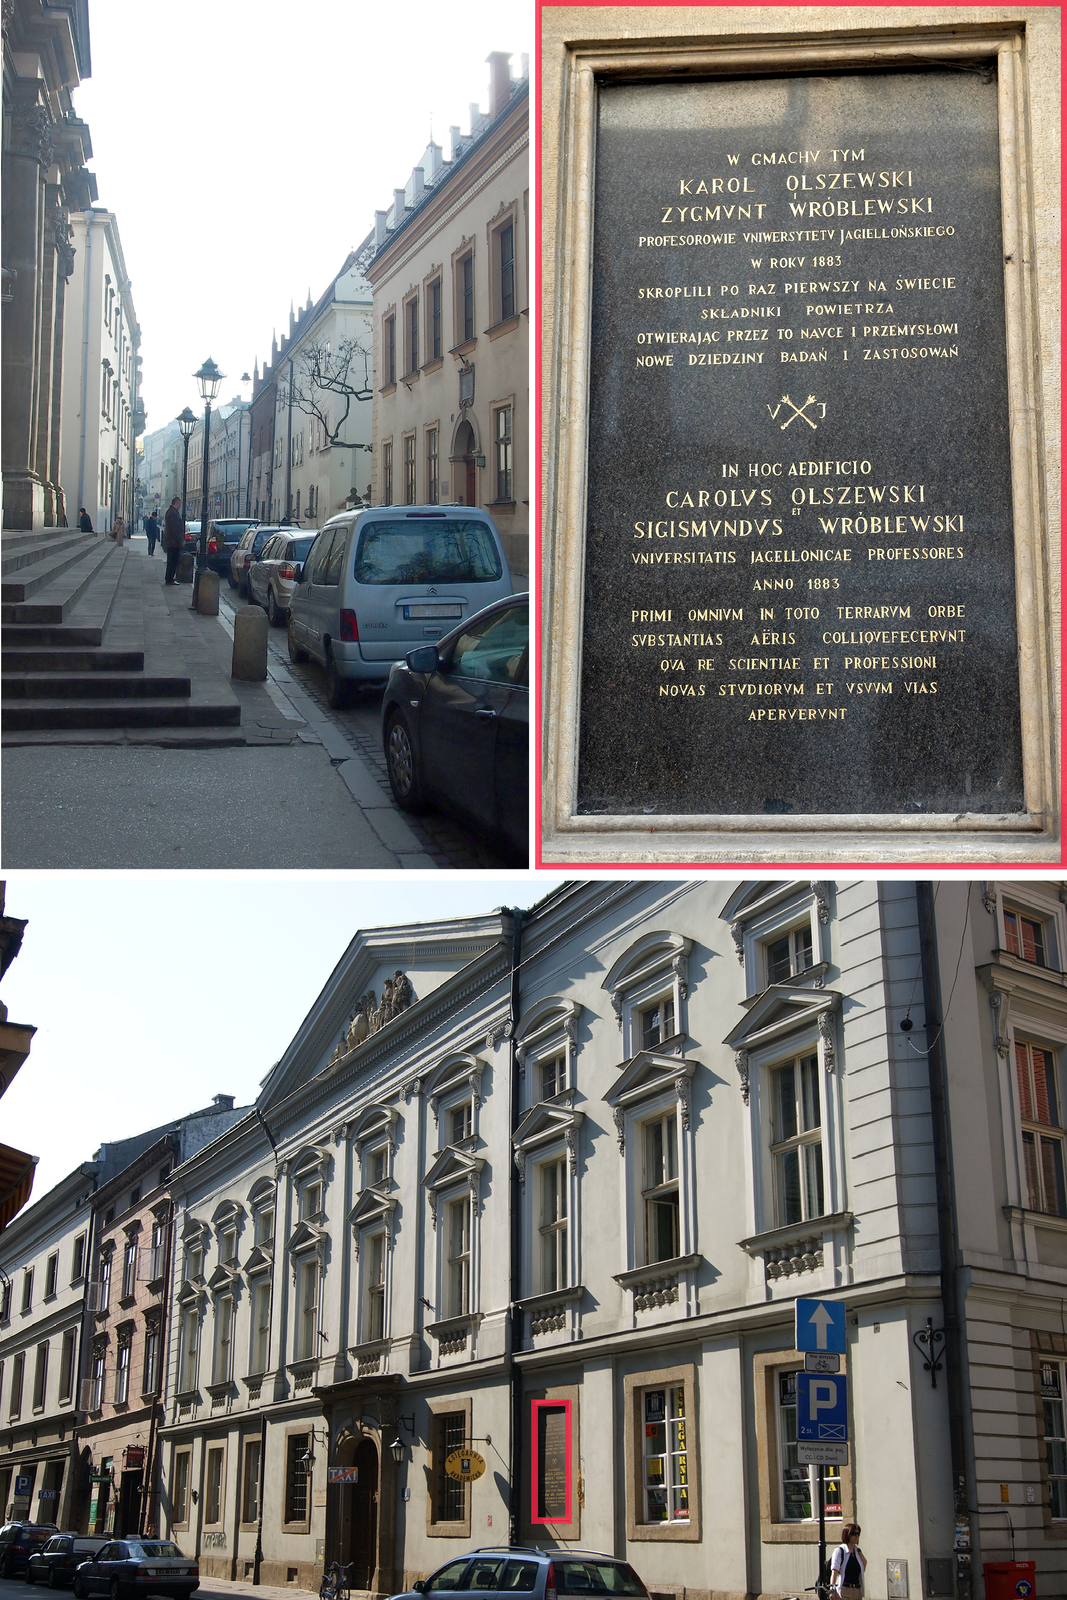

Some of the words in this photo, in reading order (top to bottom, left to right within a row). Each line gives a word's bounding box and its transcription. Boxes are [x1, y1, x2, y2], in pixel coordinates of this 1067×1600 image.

[727, 154, 741, 166] W
[752, 151, 821, 166] GMACHV
[831, 149, 865, 162] TYM
[680, 178, 756, 195] KAROL
[787, 171, 913, 191] OLSZEWSKI
[662, 204, 767, 223] ZYGMVNT
[790, 197, 933, 218] WRÓBLEWSKI
[639, 233, 736, 248] PROFESOROWIE
[743, 230, 836, 244] VNIWERSYTETV
[840, 226, 955, 246] JAGIELLOŃSKIEGO
[751, 259, 763, 269] W
[771, 257, 806, 269] ROKV
[813, 256, 842, 268] 1883
[638, 286, 712, 299] SKROPLILI
[721, 286, 739, 296] PO
[749, 284, 776, 295] RAZ
[785, 281, 860, 294] PIERWSZY
[869, 281, 887, 292] NA
[896, 275, 956, 291] ŚWIECIE
[701, 307, 781, 320] SKŁADNIKI
[807, 304, 894, 316] POWIETRZA
[638, 331, 720, 346] OTWIERAJĄC
[728, 330, 769, 342] PRZEZ
[777, 329, 793, 340] TO
[801, 327, 844, 339] NAVCE
[852, 327, 856, 338] I
[864, 324, 958, 337] PRZEMYSŁOWI
[637, 355, 674, 367] NOWE
[689, 353, 765, 366] DZIEDZINY
[781, 347, 828, 363] BADAŃ
[844, 351, 848, 361] I
[864, 344, 959, 360] ZASTOSOWAŃ
[722, 464, 739, 478] IN
[749, 463, 783, 477] HOC
[788, 461, 872, 476] AEDIFICIO
[666, 490, 772, 509] CAROLVS
[792, 485, 925, 505] OLSZEWSKI
[635, 519, 783, 539] SIGISMVNDVS
[818, 512, 964, 535] WRÓBLEWSKI
[632, 552, 736, 564] VNIVERSITATIS
[751, 549, 852, 565] JAGELLONICAE
[868, 547, 964, 561] PROFESSORES
[753, 579, 794, 591] ANNO
[808, 579, 840, 590] 1883
[632, 610, 672, 623] PRIMI
[689, 609, 743, 622] OMNIVM
[761, 608, 774, 621] IN
[785, 608, 820, 620] TOTO
[837, 606, 911, 619] TERRARVM
[929, 605, 965, 618] ORBE
[632, 634, 723, 647] SVBSTANTIAS
[751, 630, 796, 645] AËRIS
[823, 630, 966, 646] COLLIQVEFECERVNT
[661, 660, 686, 673] QVA
[698, 659, 715, 671] RE
[730, 658, 801, 670] SCIENTIAE
[814, 658, 830, 670] ET
[845, 657, 937, 669] PROFESSIONI
[660, 685, 706, 697] NOVAS
[719, 684, 805, 696] STVDIORVM
[817, 683, 834, 695] ET
[846, 683, 893, 695] VSVVM
[904, 682, 938, 694] VIAS
[748, 709, 848, 721] APERVERVNT
[809, 1379, 837, 1420] P
[801, 1426, 806, 1434] 2
[19, 1477, 28, 1490] P
[330, 1469, 357, 1481] TAXI
[449, 1470, 483, 1483] AKADEMICKA
[40, 1491, 55, 1499] TAXI
